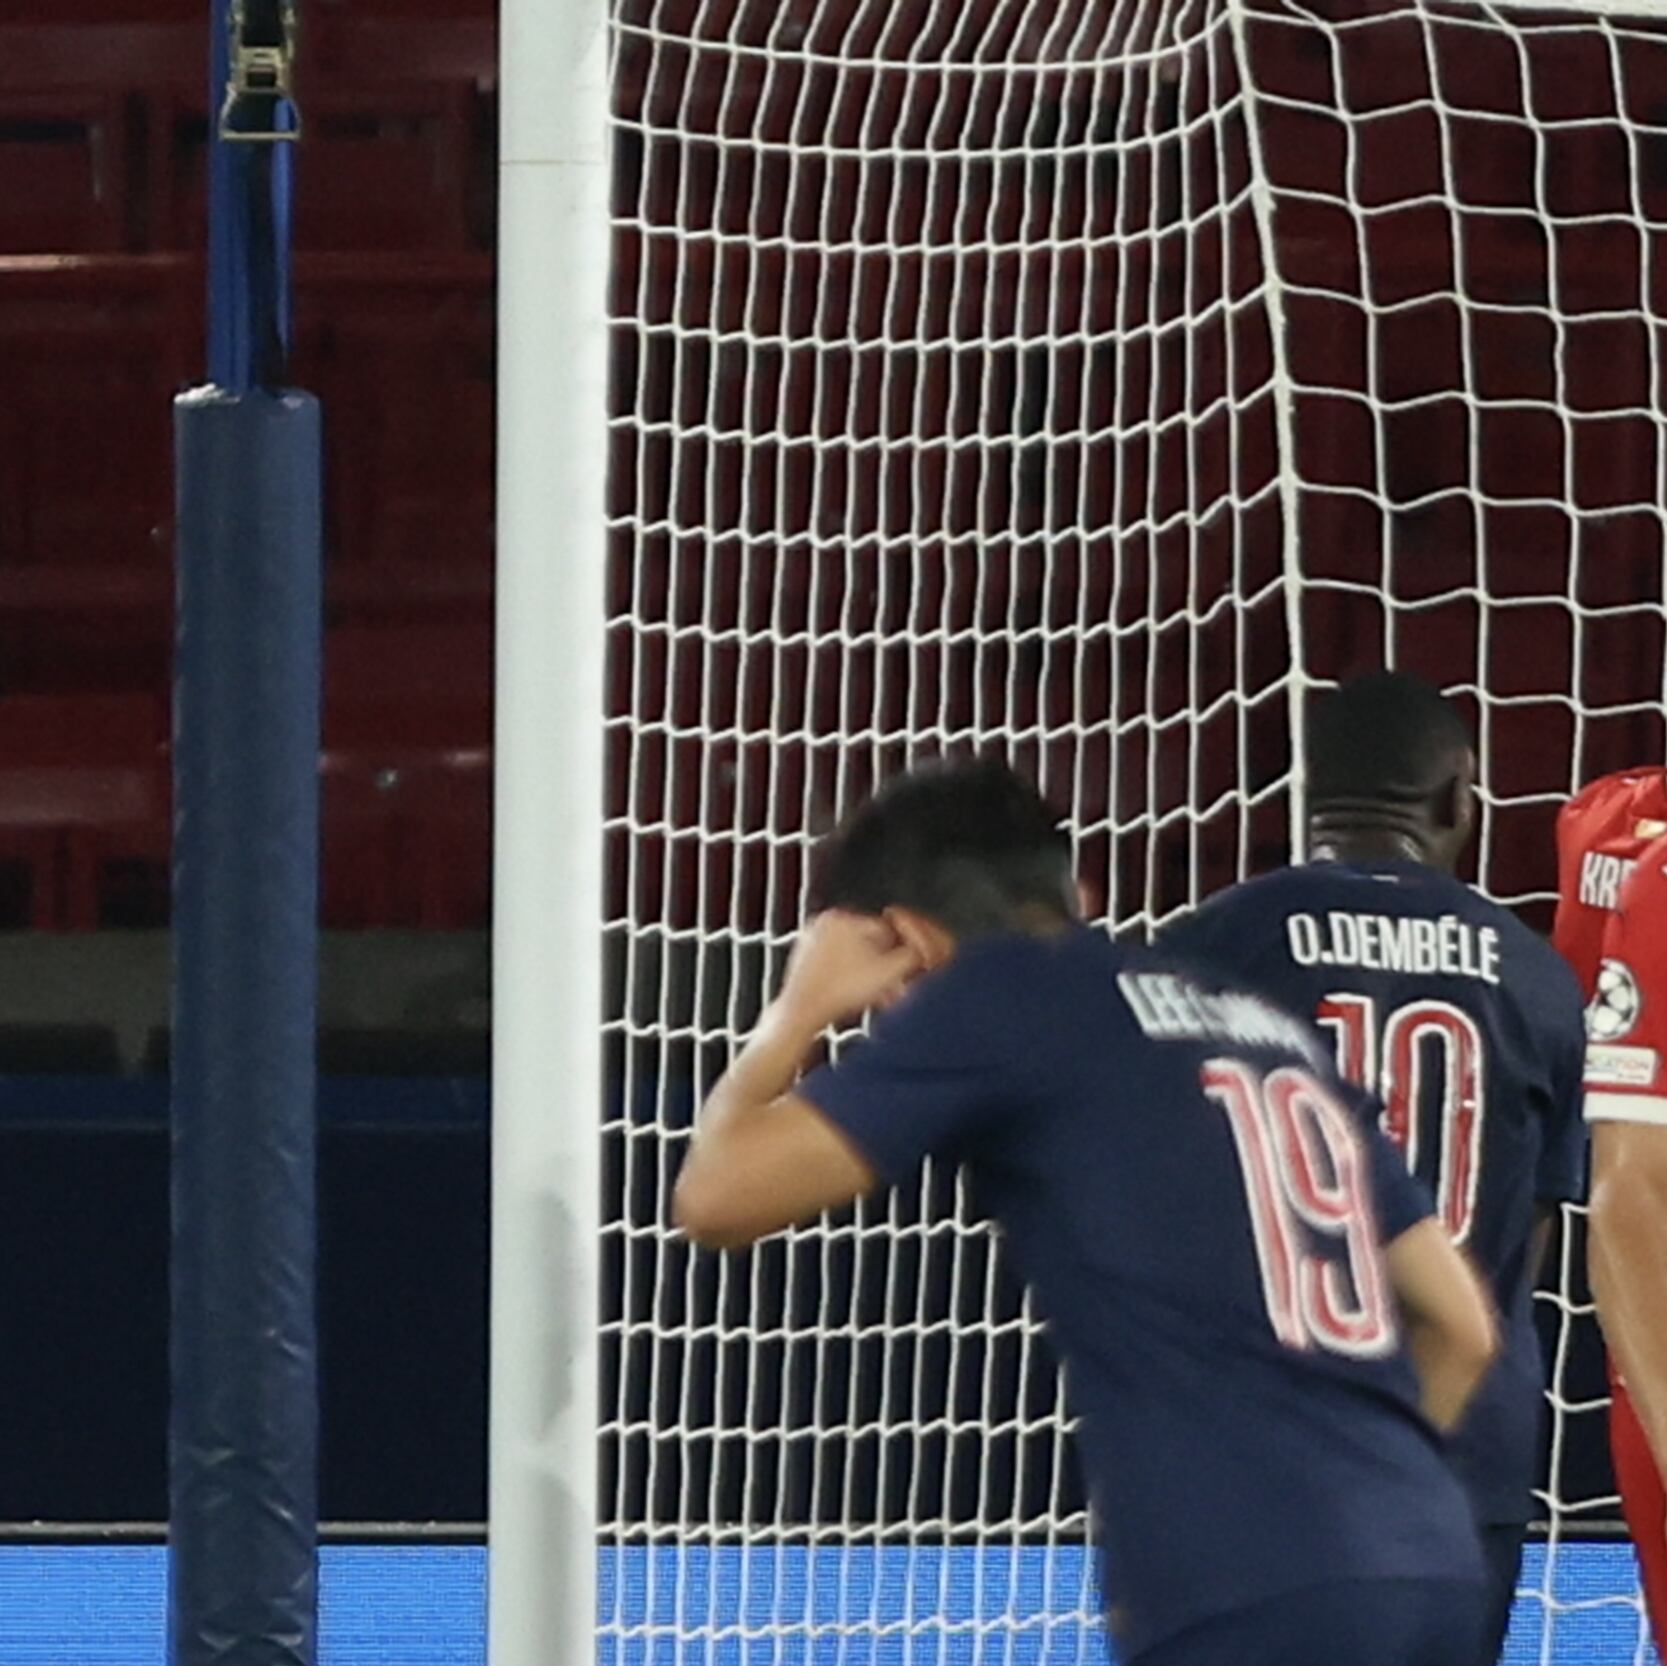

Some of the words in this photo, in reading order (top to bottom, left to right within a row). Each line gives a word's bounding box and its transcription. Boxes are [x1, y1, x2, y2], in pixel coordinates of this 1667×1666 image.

[1287, 911, 1500, 985] O.DEMBÉLÉ
[1200, 1058, 1397, 1360] 19
[1316, 991, 1482, 1246] 10
